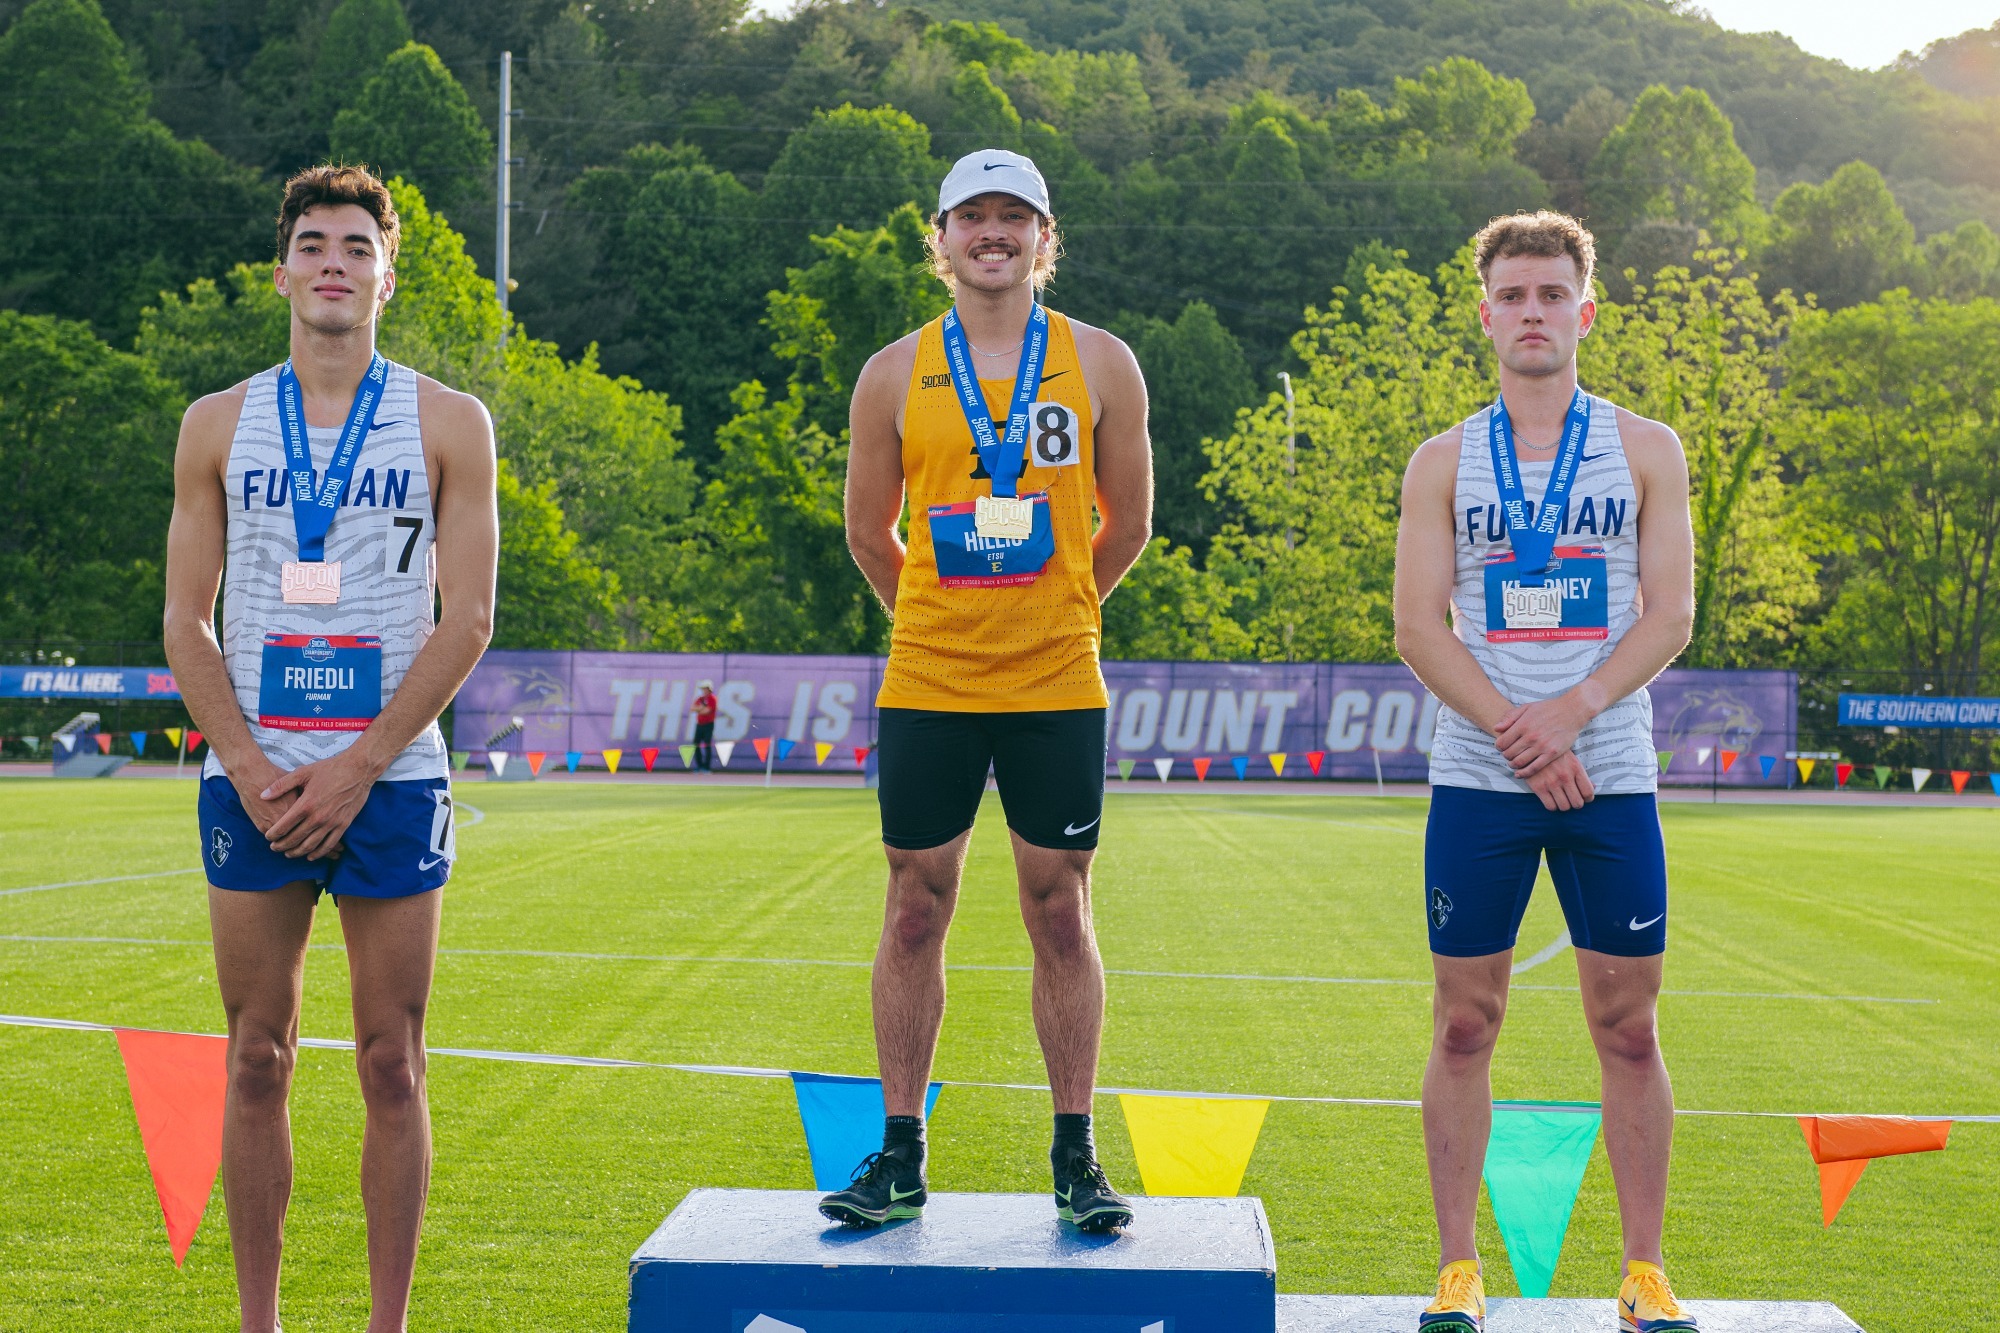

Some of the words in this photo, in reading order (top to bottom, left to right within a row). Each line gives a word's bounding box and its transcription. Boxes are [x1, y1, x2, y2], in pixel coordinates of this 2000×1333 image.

[1029, 331, 1042, 368] CONFERENCE
[921, 373, 951, 390] SOCON
[1024, 364, 1038, 393] SOUTHERN
[354, 390, 375, 426] CONFERENCE
[1020, 391, 1030, 402] THE
[342, 425, 361, 456] SOUTHERN
[971, 416, 997, 448] SOCON
[1007, 413, 1029, 443] SOCON
[1036, 405, 1072, 463] 8
[1568, 421, 1583, 455] CONFERENCE
[337, 456, 349, 467] THE
[1559, 452, 1575, 484] SOUTHERN
[243, 467, 411, 511] FUAN
[292, 471, 313, 502] SOCON
[318, 477, 344, 508] SOCON
[1554, 482, 1566, 493] THE
[978, 498, 1031, 529] SOCON
[1466, 496, 1626, 545] FUAN
[1505, 499, 1529, 530] SOCON
[1537, 503, 1562, 534] SOCON
[393, 516, 424, 574] 7
[987, 552, 1005, 561] ETSU
[284, 564, 340, 592] SOCON
[1501, 578, 1592, 599] KNEY
[1506, 590, 1559, 619] SOCON
[22, 671, 52, 692] IT'S
[52, 672, 79, 693] ALL
[81, 672, 125, 693] HERE.
[147, 673, 181, 695] SOC
[284, 666, 355, 690] FRIEDLI
[305, 692, 332, 701] FURMAN
[1848, 699, 1876, 721] THE
[1877, 700, 1958, 723] SOUTHERN
[786, 680, 858, 743] IS
[1106, 689, 1300, 753] OUNT
